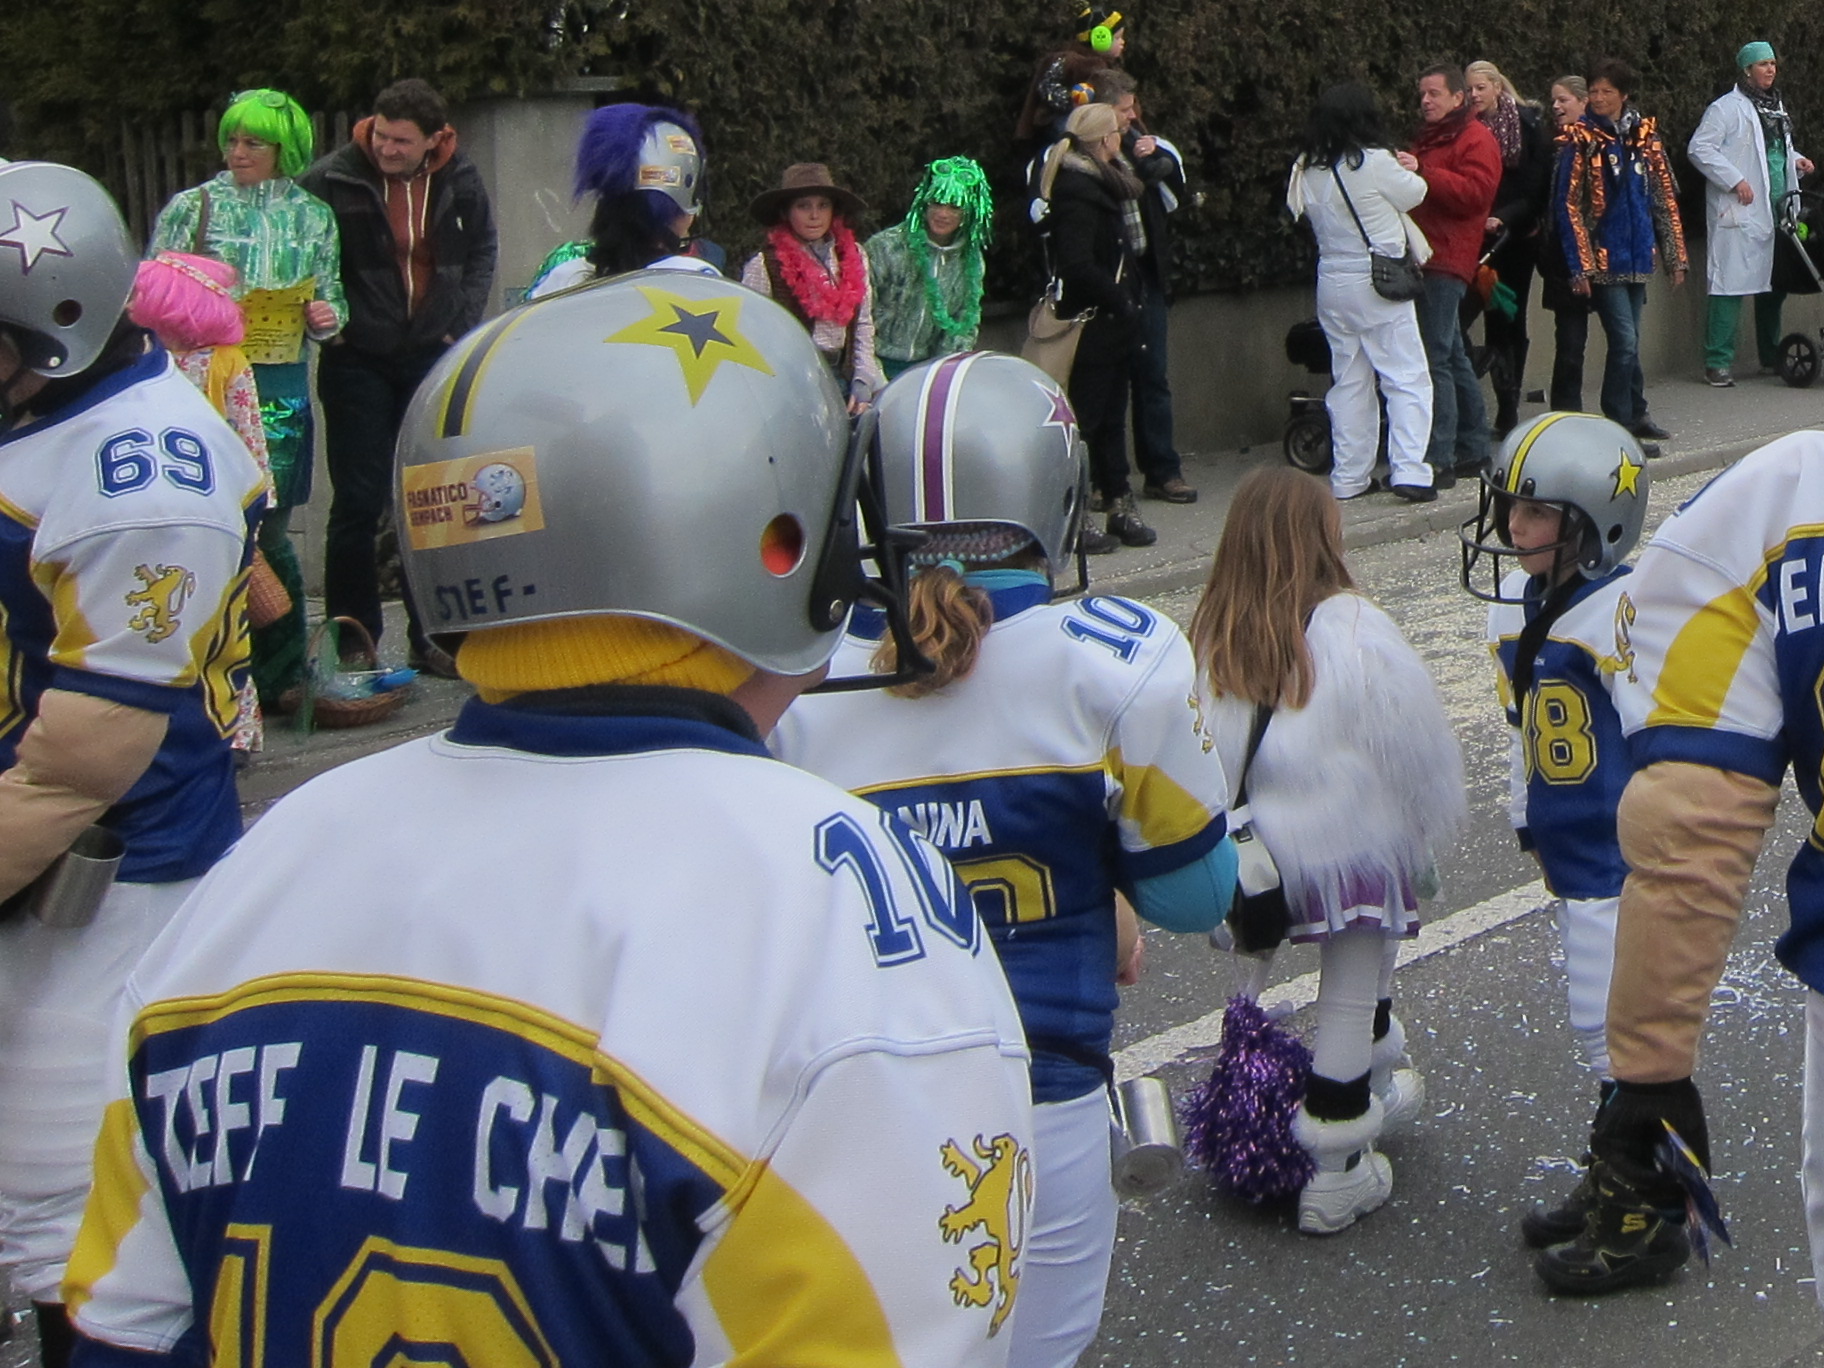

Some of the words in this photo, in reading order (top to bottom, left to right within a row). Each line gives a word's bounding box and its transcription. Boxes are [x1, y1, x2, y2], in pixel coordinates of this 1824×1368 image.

[96, 427, 216, 499] 69
[407, 482, 468, 509] FASNATICO
[1059, 594, 1157, 665] 10
[340, 1043, 441, 1202] LE
